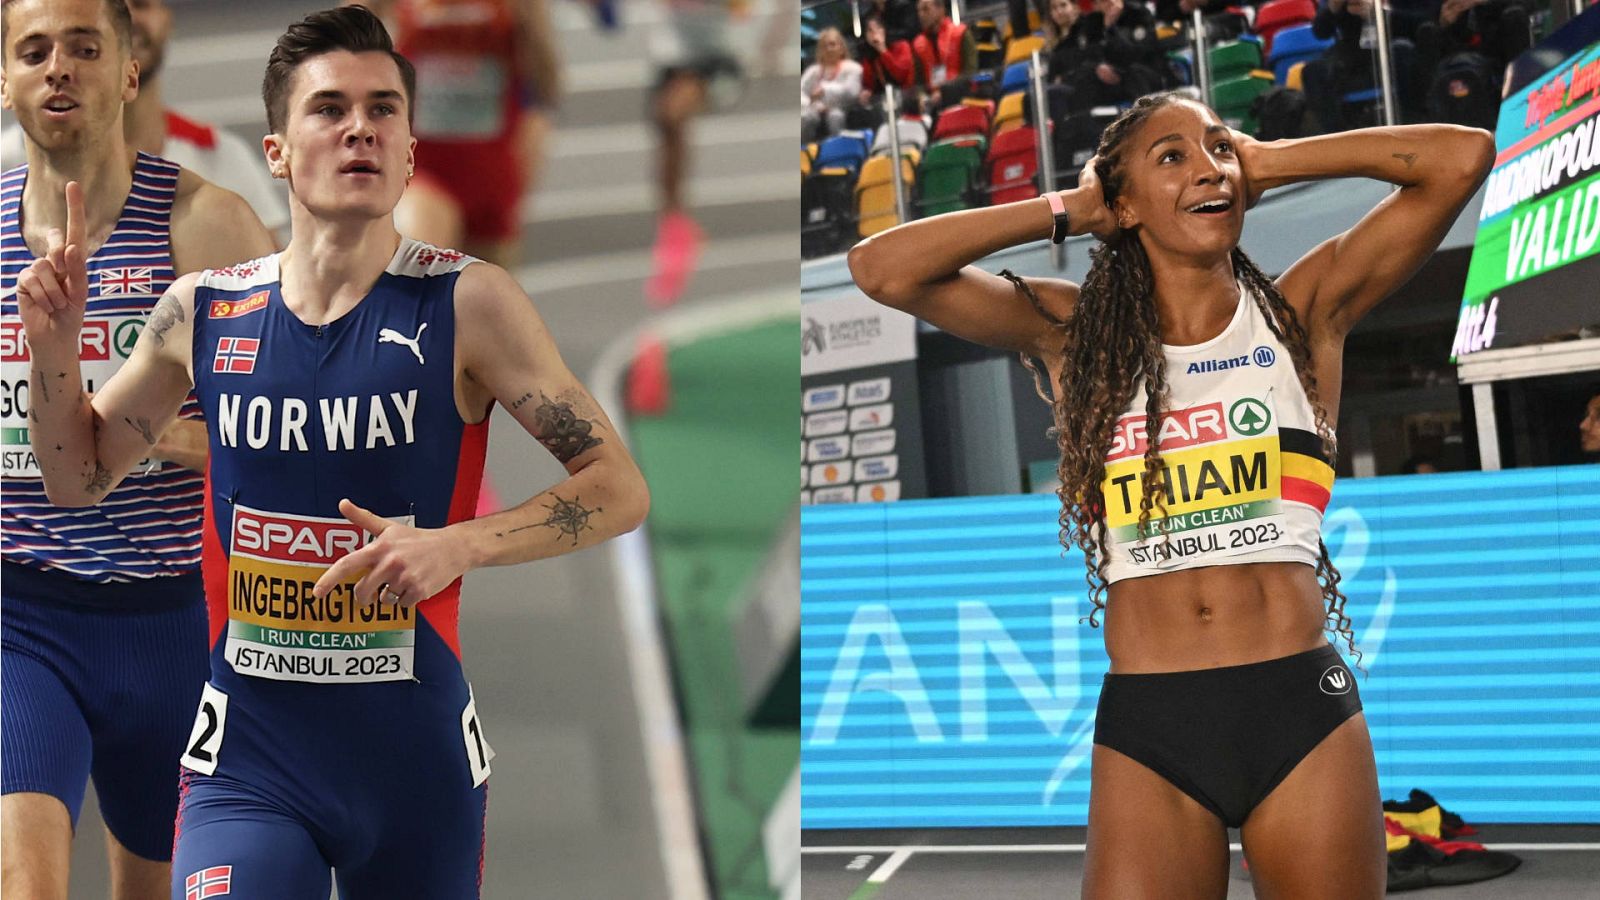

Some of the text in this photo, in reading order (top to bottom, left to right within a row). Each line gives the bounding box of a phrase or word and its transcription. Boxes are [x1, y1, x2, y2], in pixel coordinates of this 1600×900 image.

[1566, 57, 1600, 107] Jum
[1504, 180, 1600, 281] VALID
[232, 295, 265, 314] EXTRA
[1186, 354, 1250, 374] Allianz
[218, 389, 418, 451] NORWAY
[1107, 408, 1223, 456] SPAR
[1111, 451, 1268, 515] THIAM
[237, 517, 360, 558] SPAR
[1128, 523, 1280, 564] ISTANBUL 2023
[235, 647, 401, 676] ISTANBUL 2023
[268, 630, 304, 646] RUN
[188, 701, 218, 762] 2
[468, 715, 486, 772] 1
